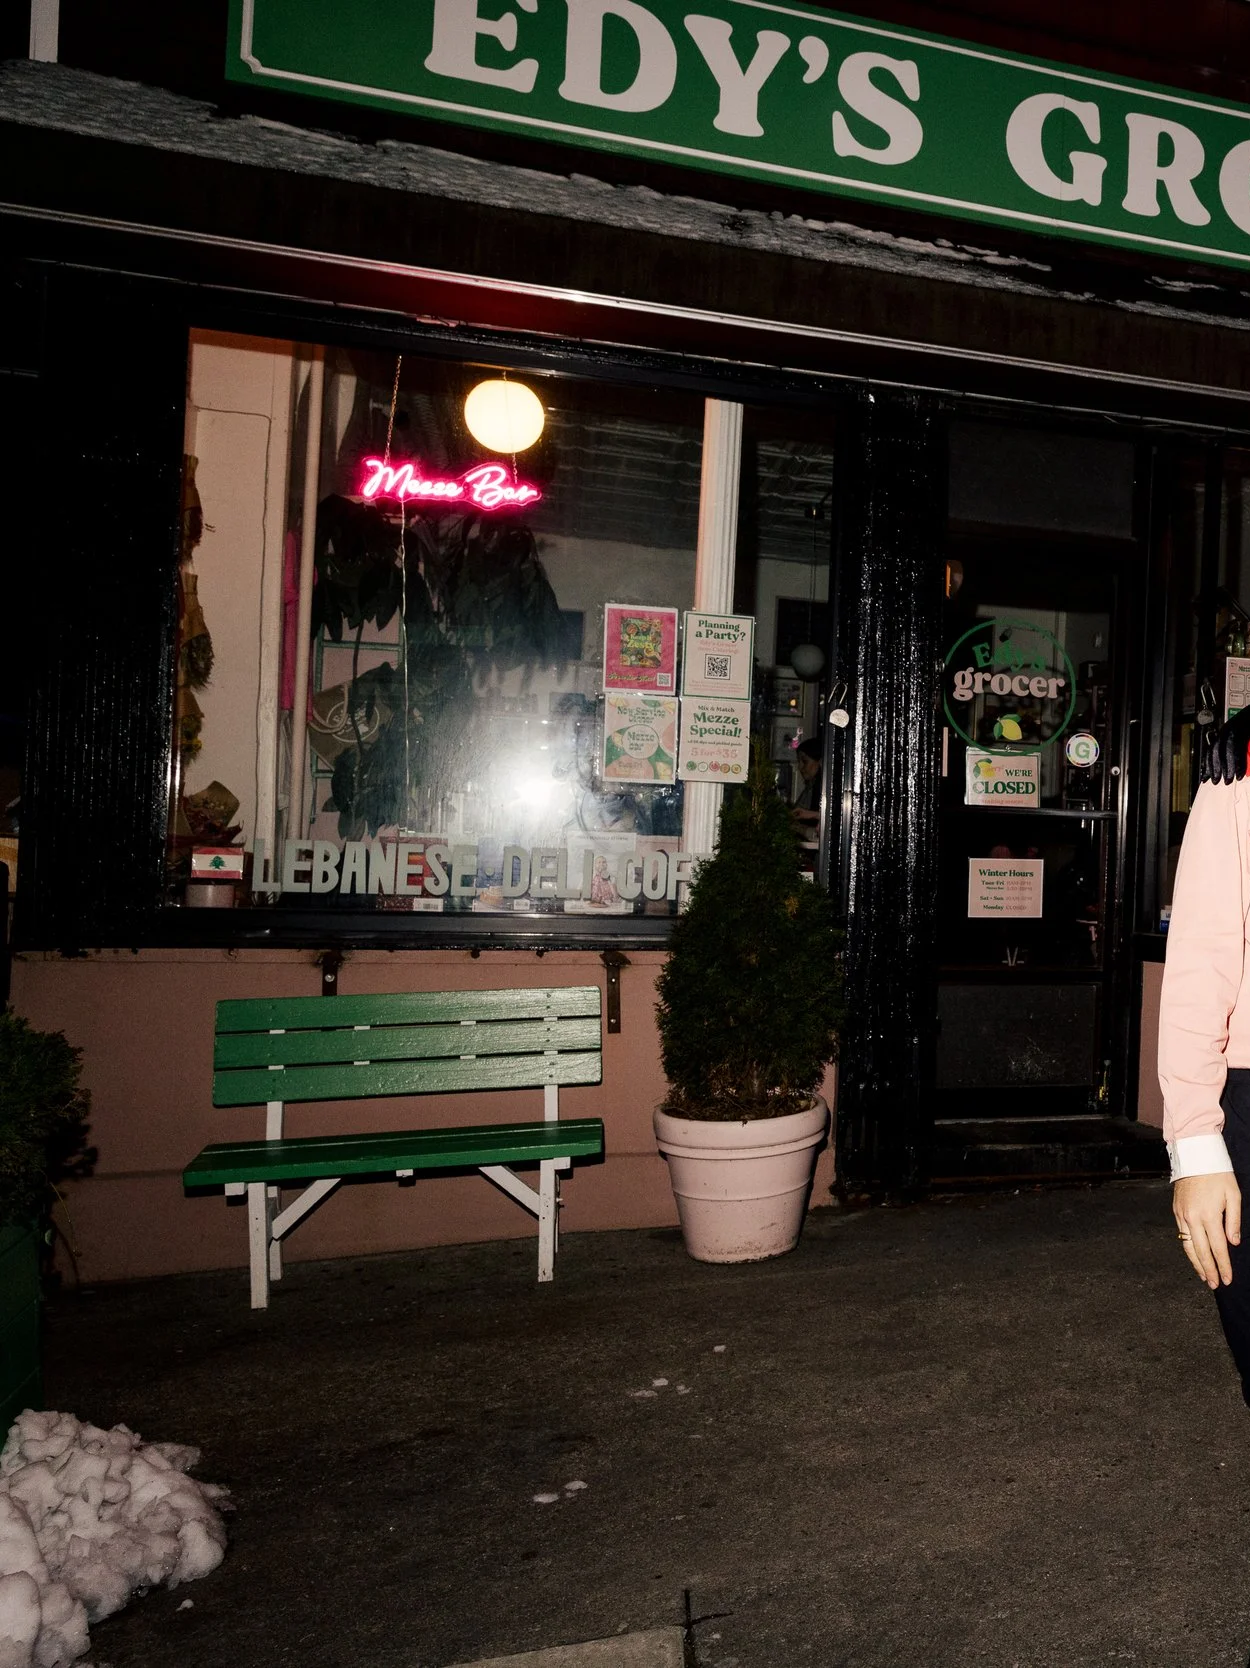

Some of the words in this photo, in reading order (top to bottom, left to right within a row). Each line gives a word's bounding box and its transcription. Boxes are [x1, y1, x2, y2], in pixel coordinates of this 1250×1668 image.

[424, 0, 924, 165] EDY'S
[466, 465, 538, 507] Bar
[698, 619, 741, 633] Planning
[695, 630, 703, 638] a
[705, 629, 746, 643] Party?
[953, 667, 1065, 701] grocer
[693, 712, 739, 725] Mezze
[690, 724, 742, 738] Special!
[1005, 769, 1033, 777] WE'RE
[972, 781, 1036, 795] CLOSED
[251, 838, 480, 897] LEBANESE
[502, 845, 594, 900] DELI
[979, 868, 1008, 877] Winter
[1009, 869, 1034, 877] Hours
